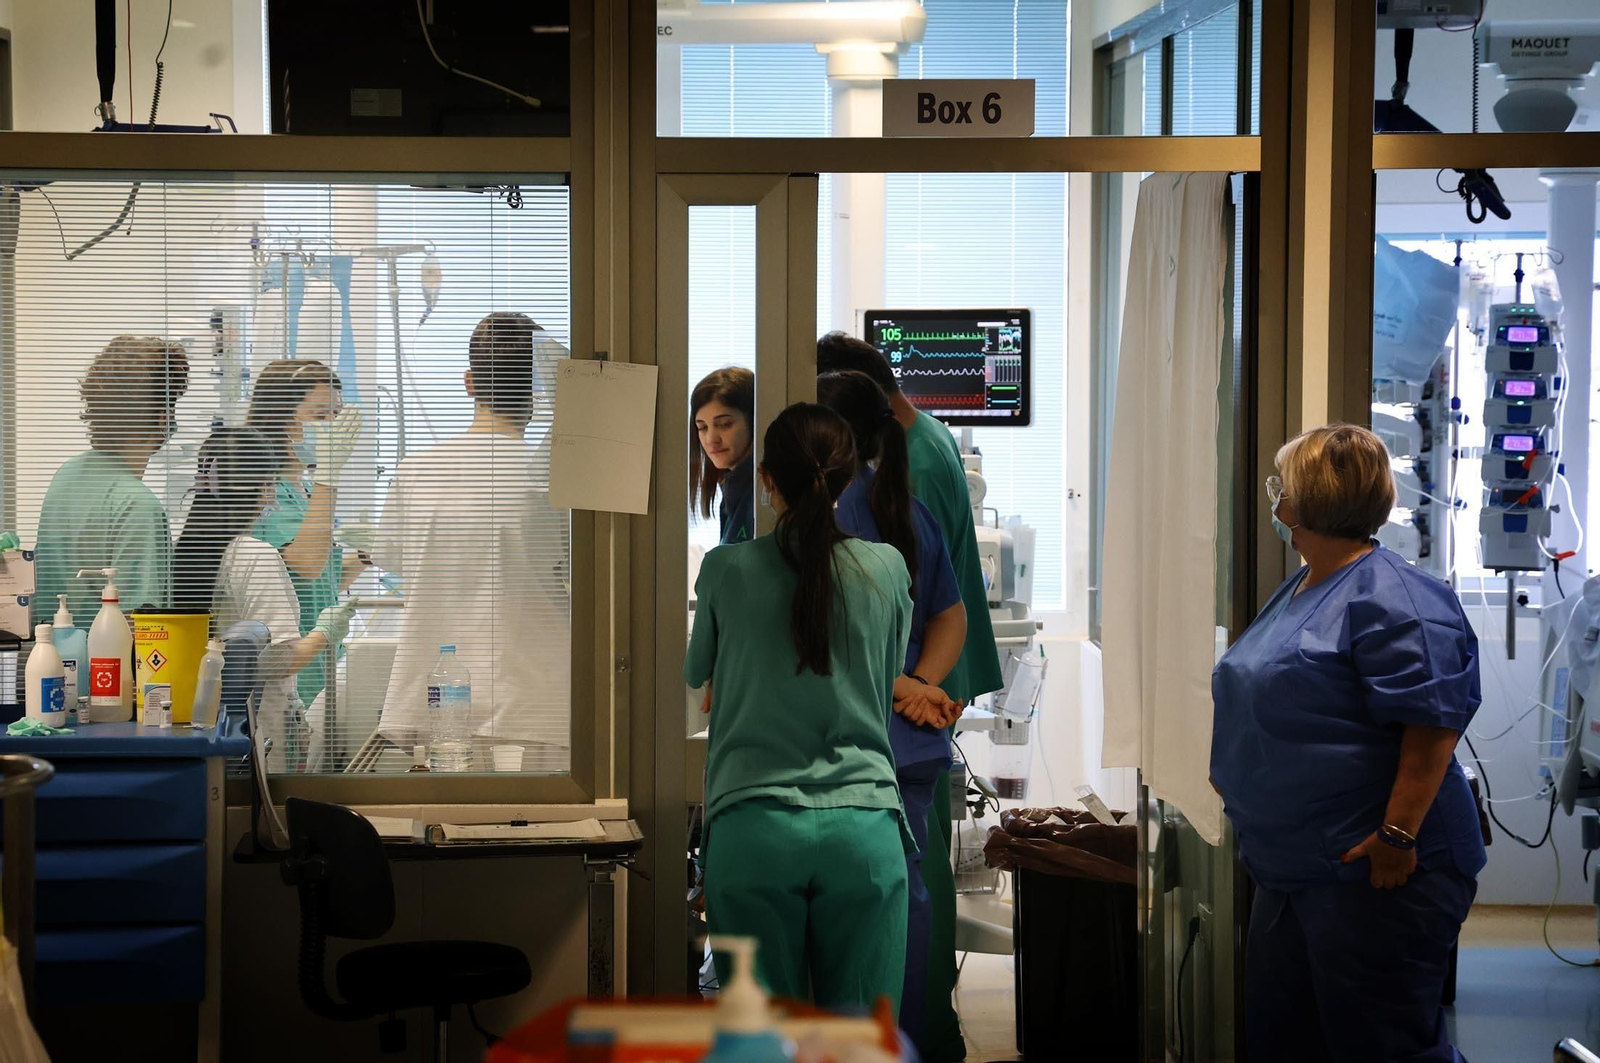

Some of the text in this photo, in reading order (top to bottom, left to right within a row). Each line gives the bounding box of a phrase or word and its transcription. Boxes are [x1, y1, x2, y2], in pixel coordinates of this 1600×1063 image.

[1511, 37, 1571, 49] MAQUET
[917, 92, 1002, 124] Box 6
[880, 328, 902, 341] 105
[890, 351, 902, 363] 99
[211, 786, 220, 801] 3
